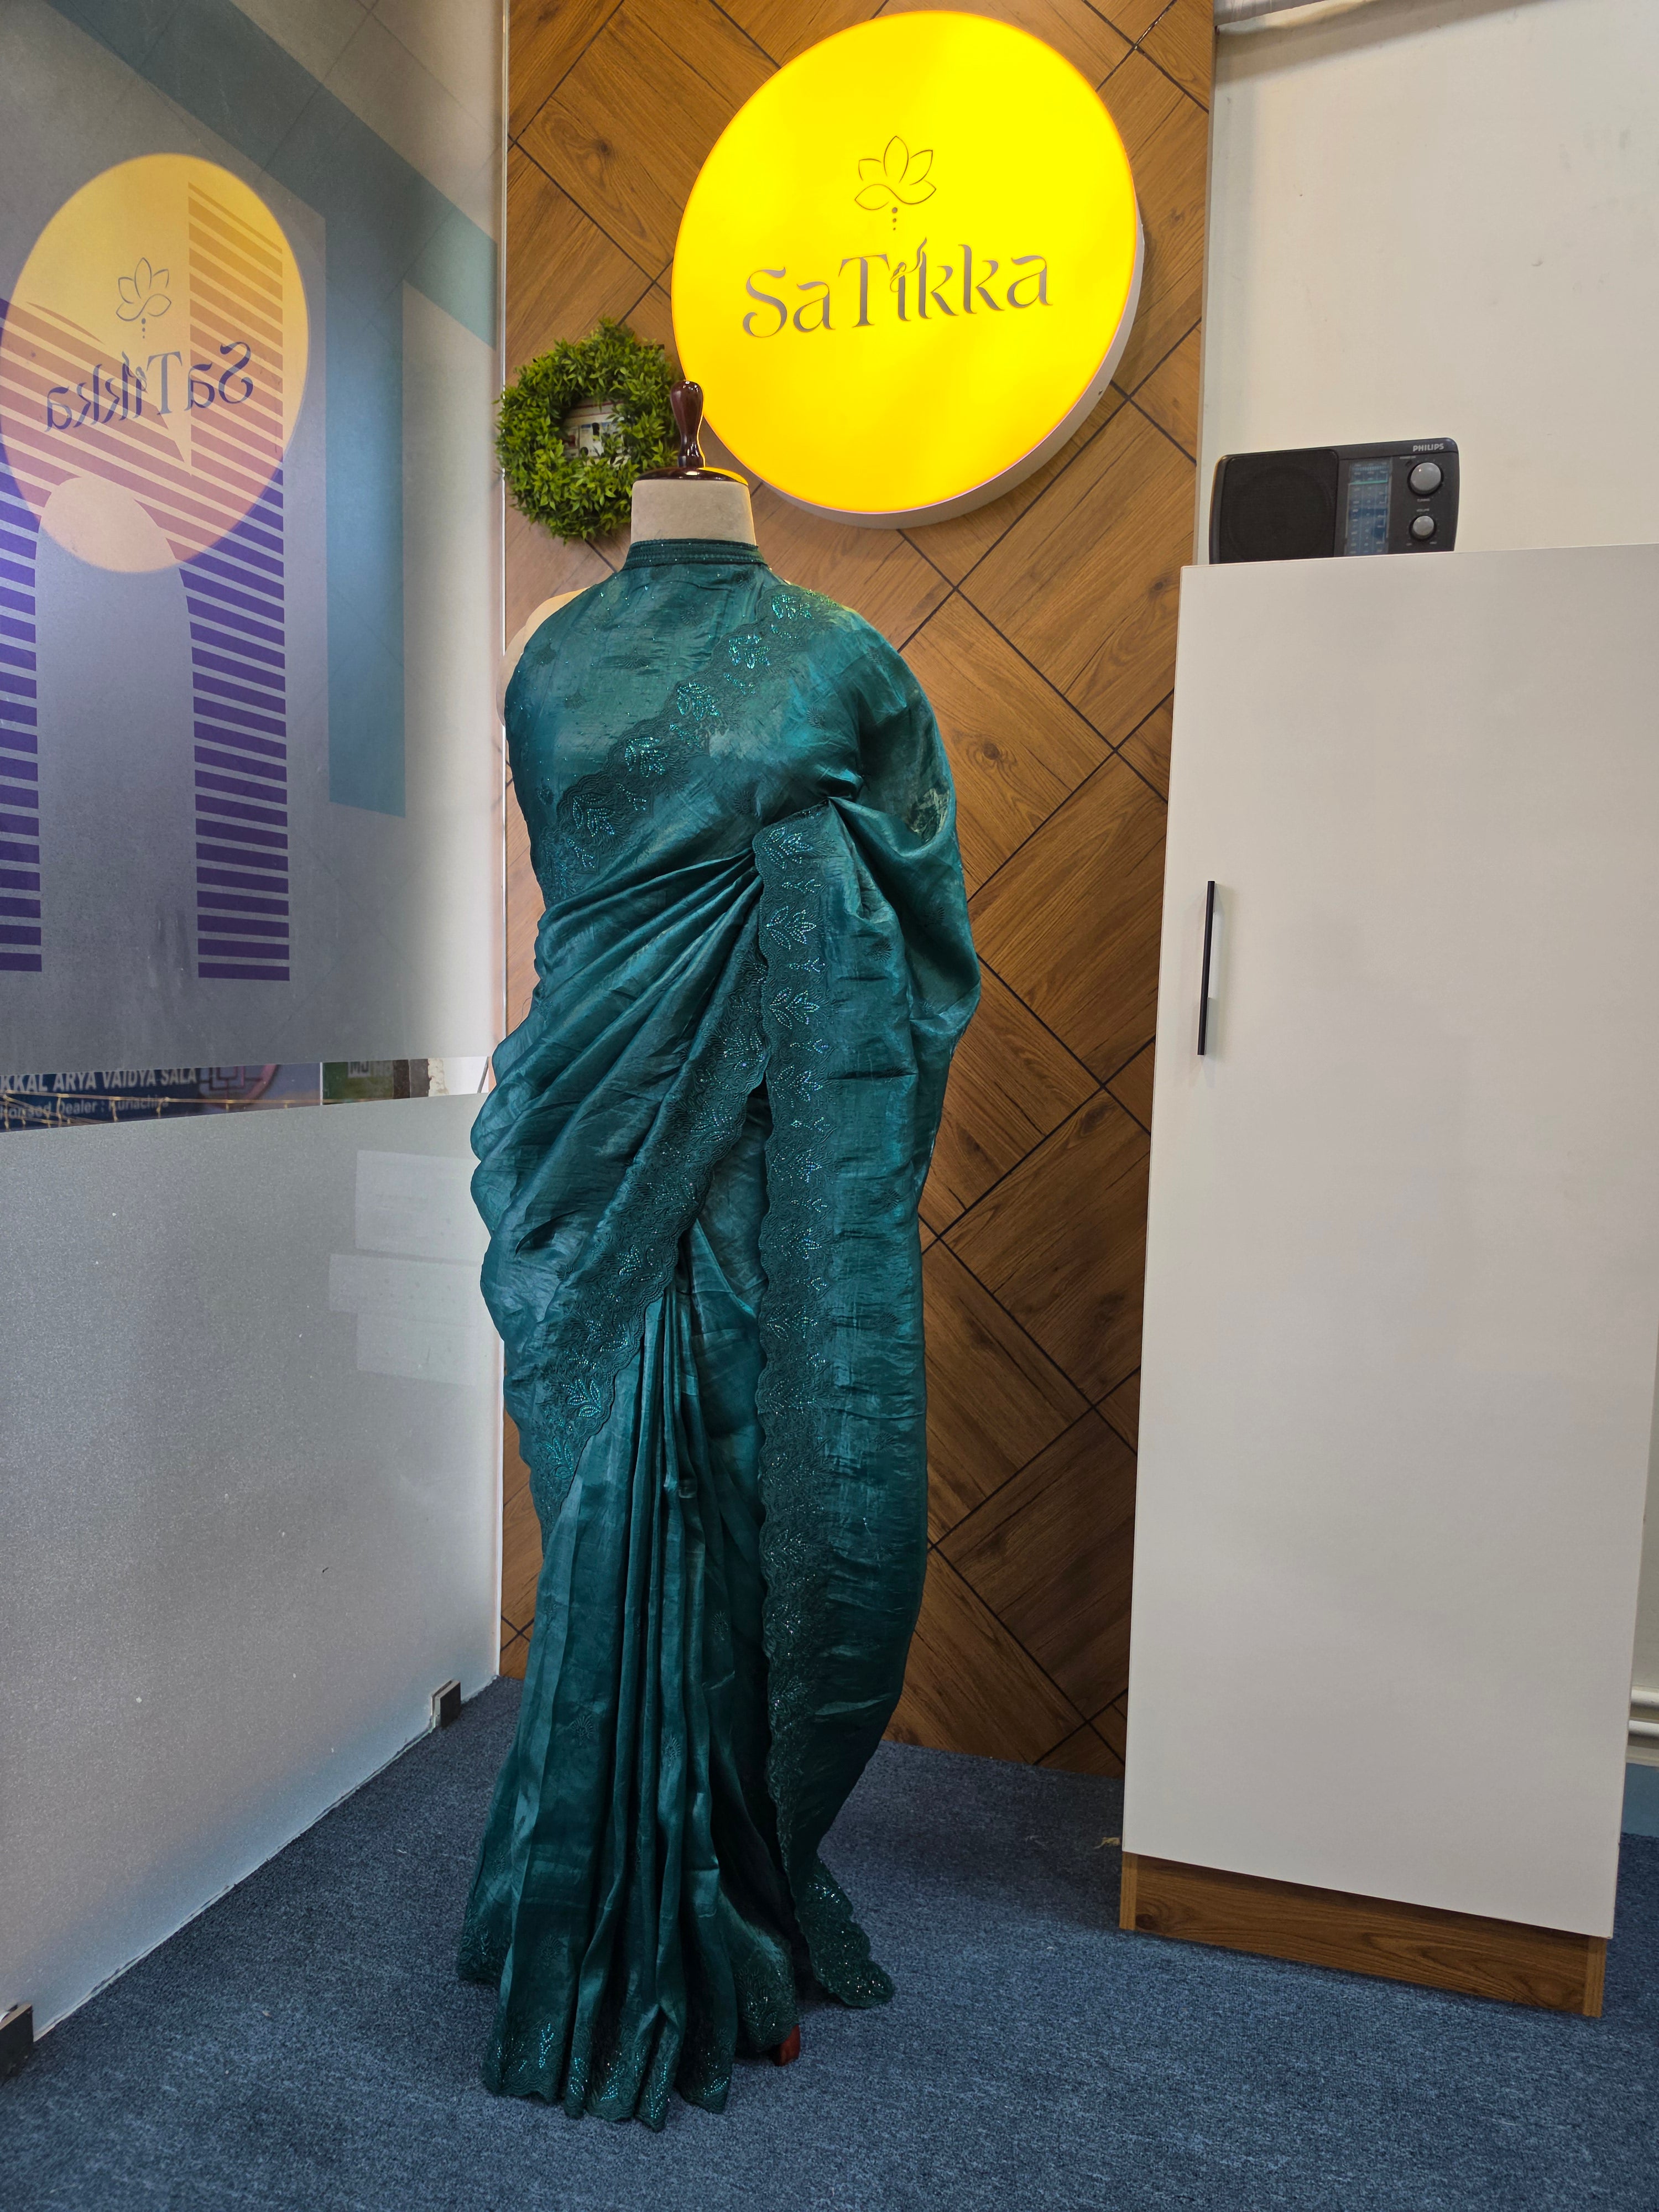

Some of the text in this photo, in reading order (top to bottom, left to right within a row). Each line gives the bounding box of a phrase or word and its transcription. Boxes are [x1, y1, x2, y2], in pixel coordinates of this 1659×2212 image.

[743, 237, 1053, 338] SaTikka
[1412, 443, 1444, 452] PHILIPS
[53, 1071, 97, 1092] ARYA
[102, 1070, 156, 1089] VAIDYA
[160, 1068, 198, 1086] SALA
